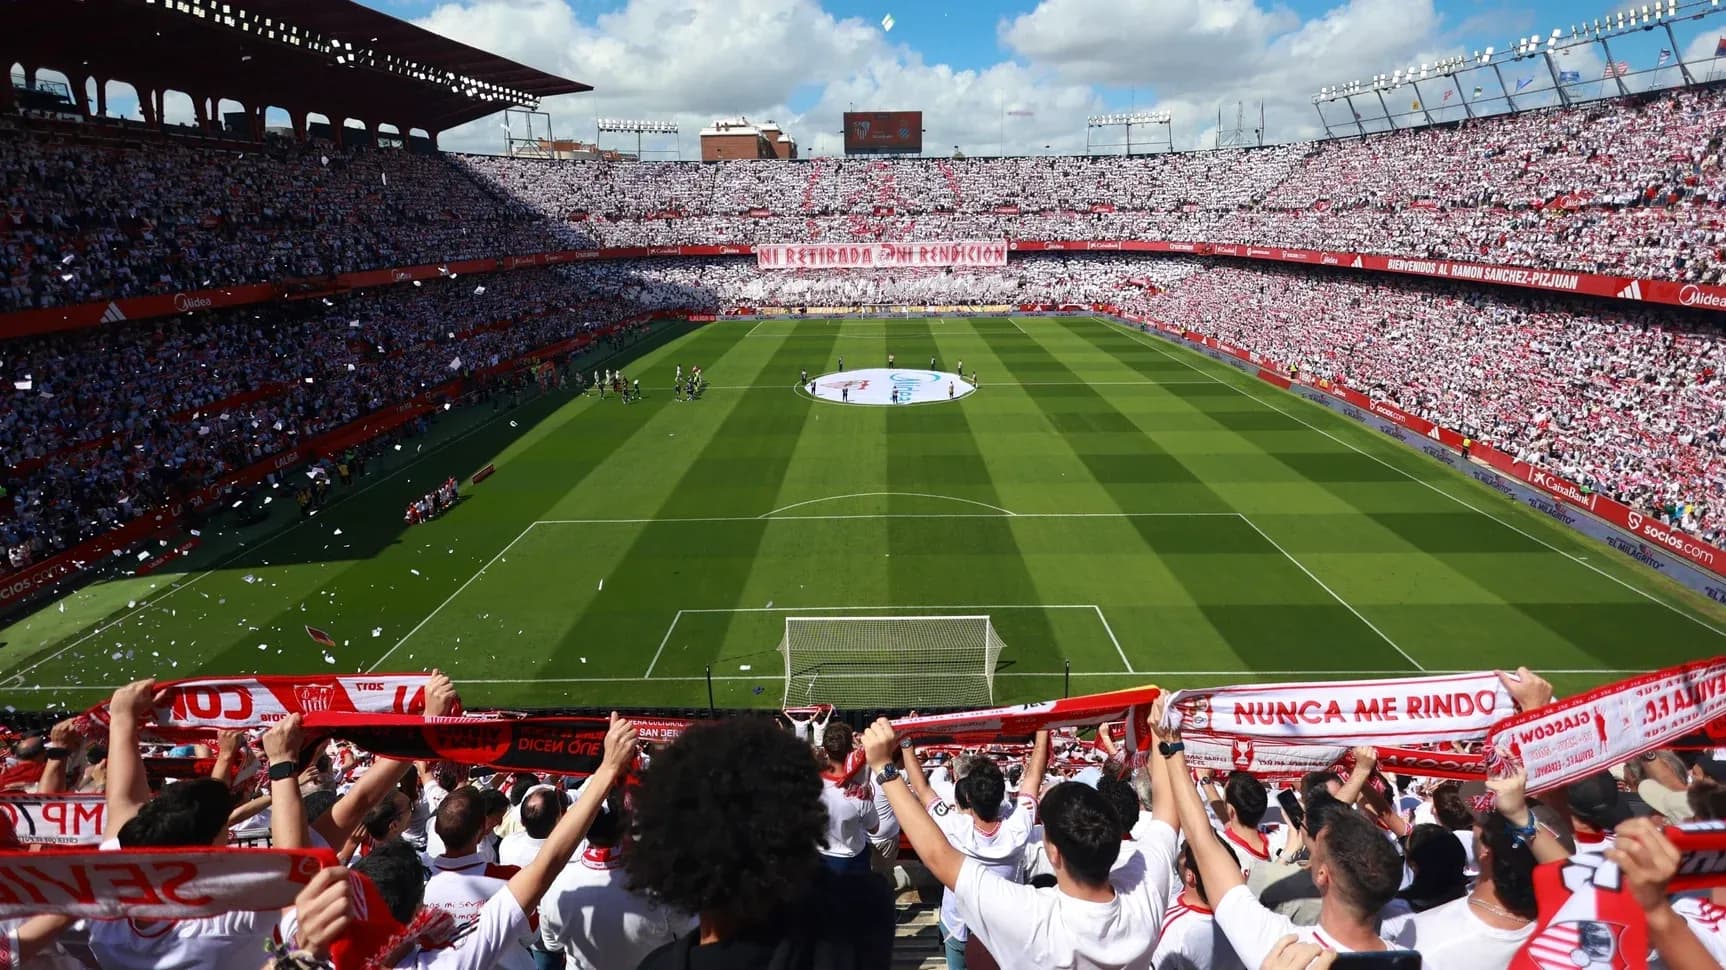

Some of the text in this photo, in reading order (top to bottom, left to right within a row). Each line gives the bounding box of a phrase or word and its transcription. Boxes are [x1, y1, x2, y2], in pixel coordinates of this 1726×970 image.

[759, 244, 1005, 264] NI RETIRADA NI RENDICION
[1387, 258, 1579, 290] BIENVENIDOS AL RAMON SANCHEZ-PIZJUAN
[177, 294, 212, 311] Midea
[1681, 286, 1726, 305] Midea
[1545, 476, 1590, 506] CaixaBank
[1233, 690, 1497, 725] NUNCA ME RINDO
[639, 728, 659, 737] SAN
